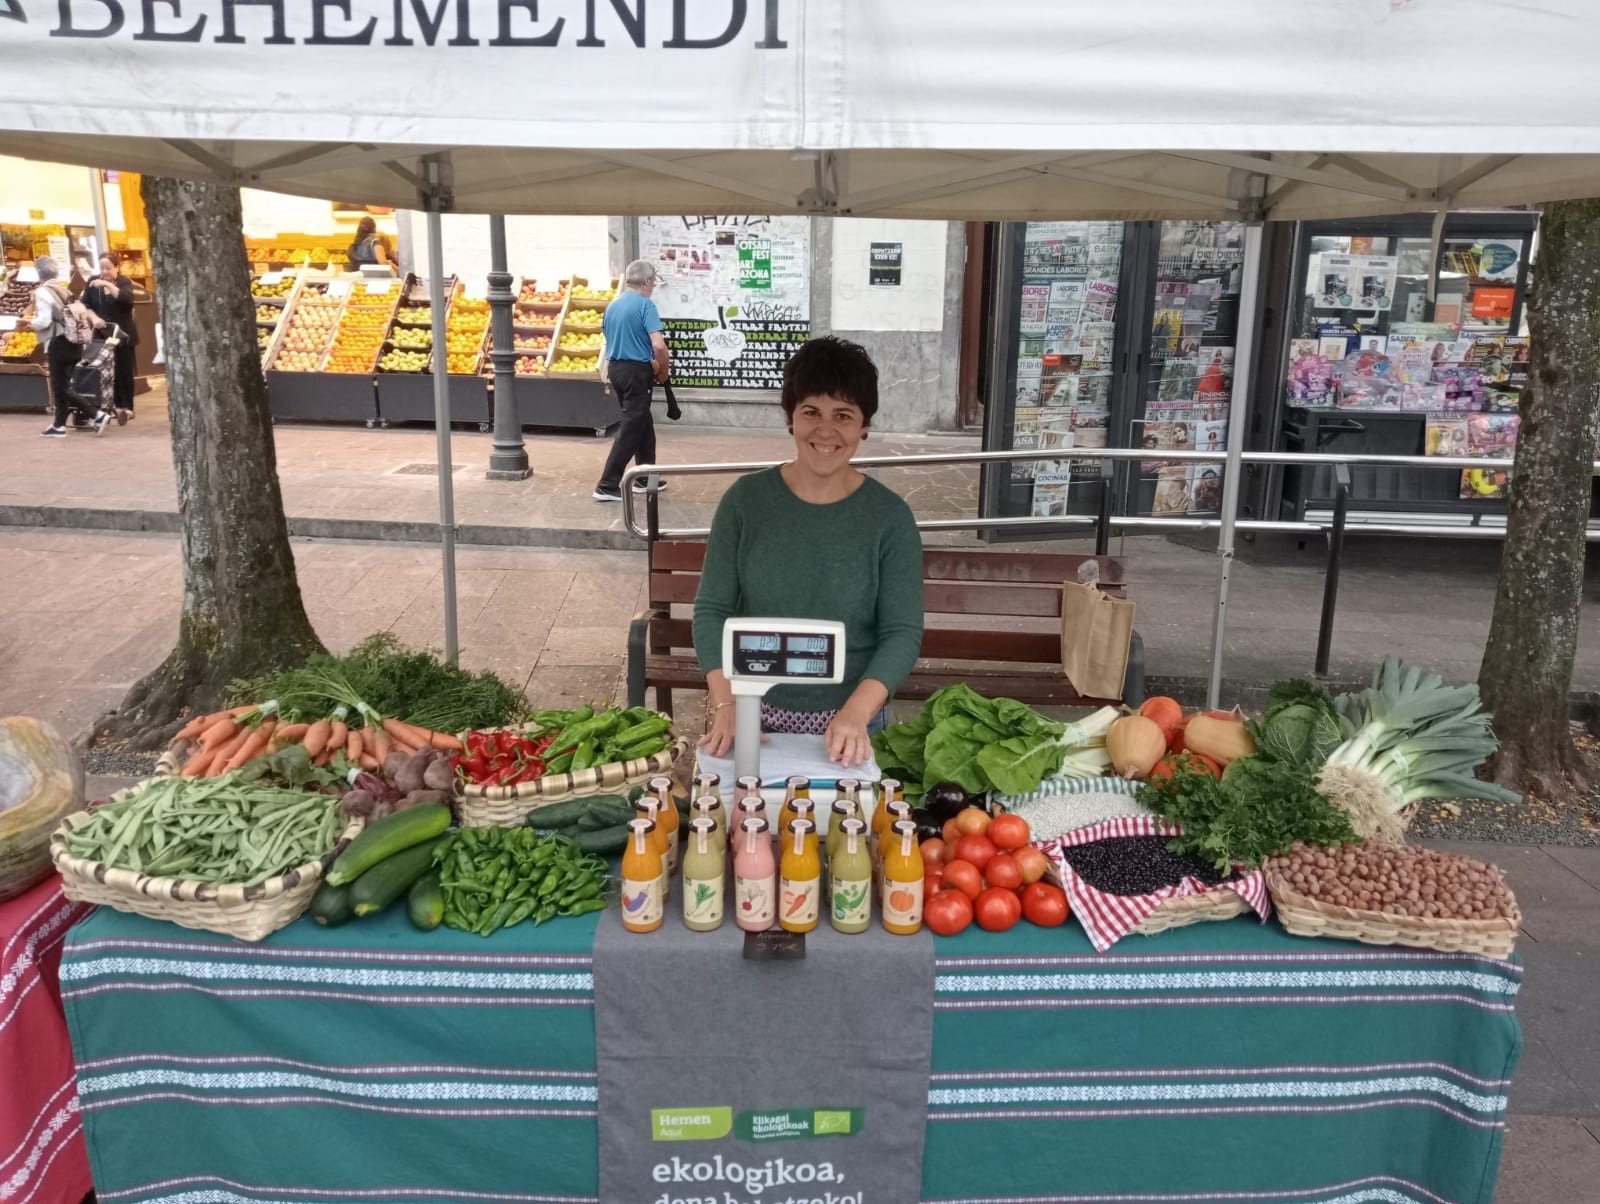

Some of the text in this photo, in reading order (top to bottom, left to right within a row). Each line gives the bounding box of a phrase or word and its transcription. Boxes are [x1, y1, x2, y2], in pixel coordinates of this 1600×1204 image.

[752, 251, 770, 260] FEST
[659, 1114, 711, 1126] Hemen
[652, 1154, 845, 1195] ekologikoa,
